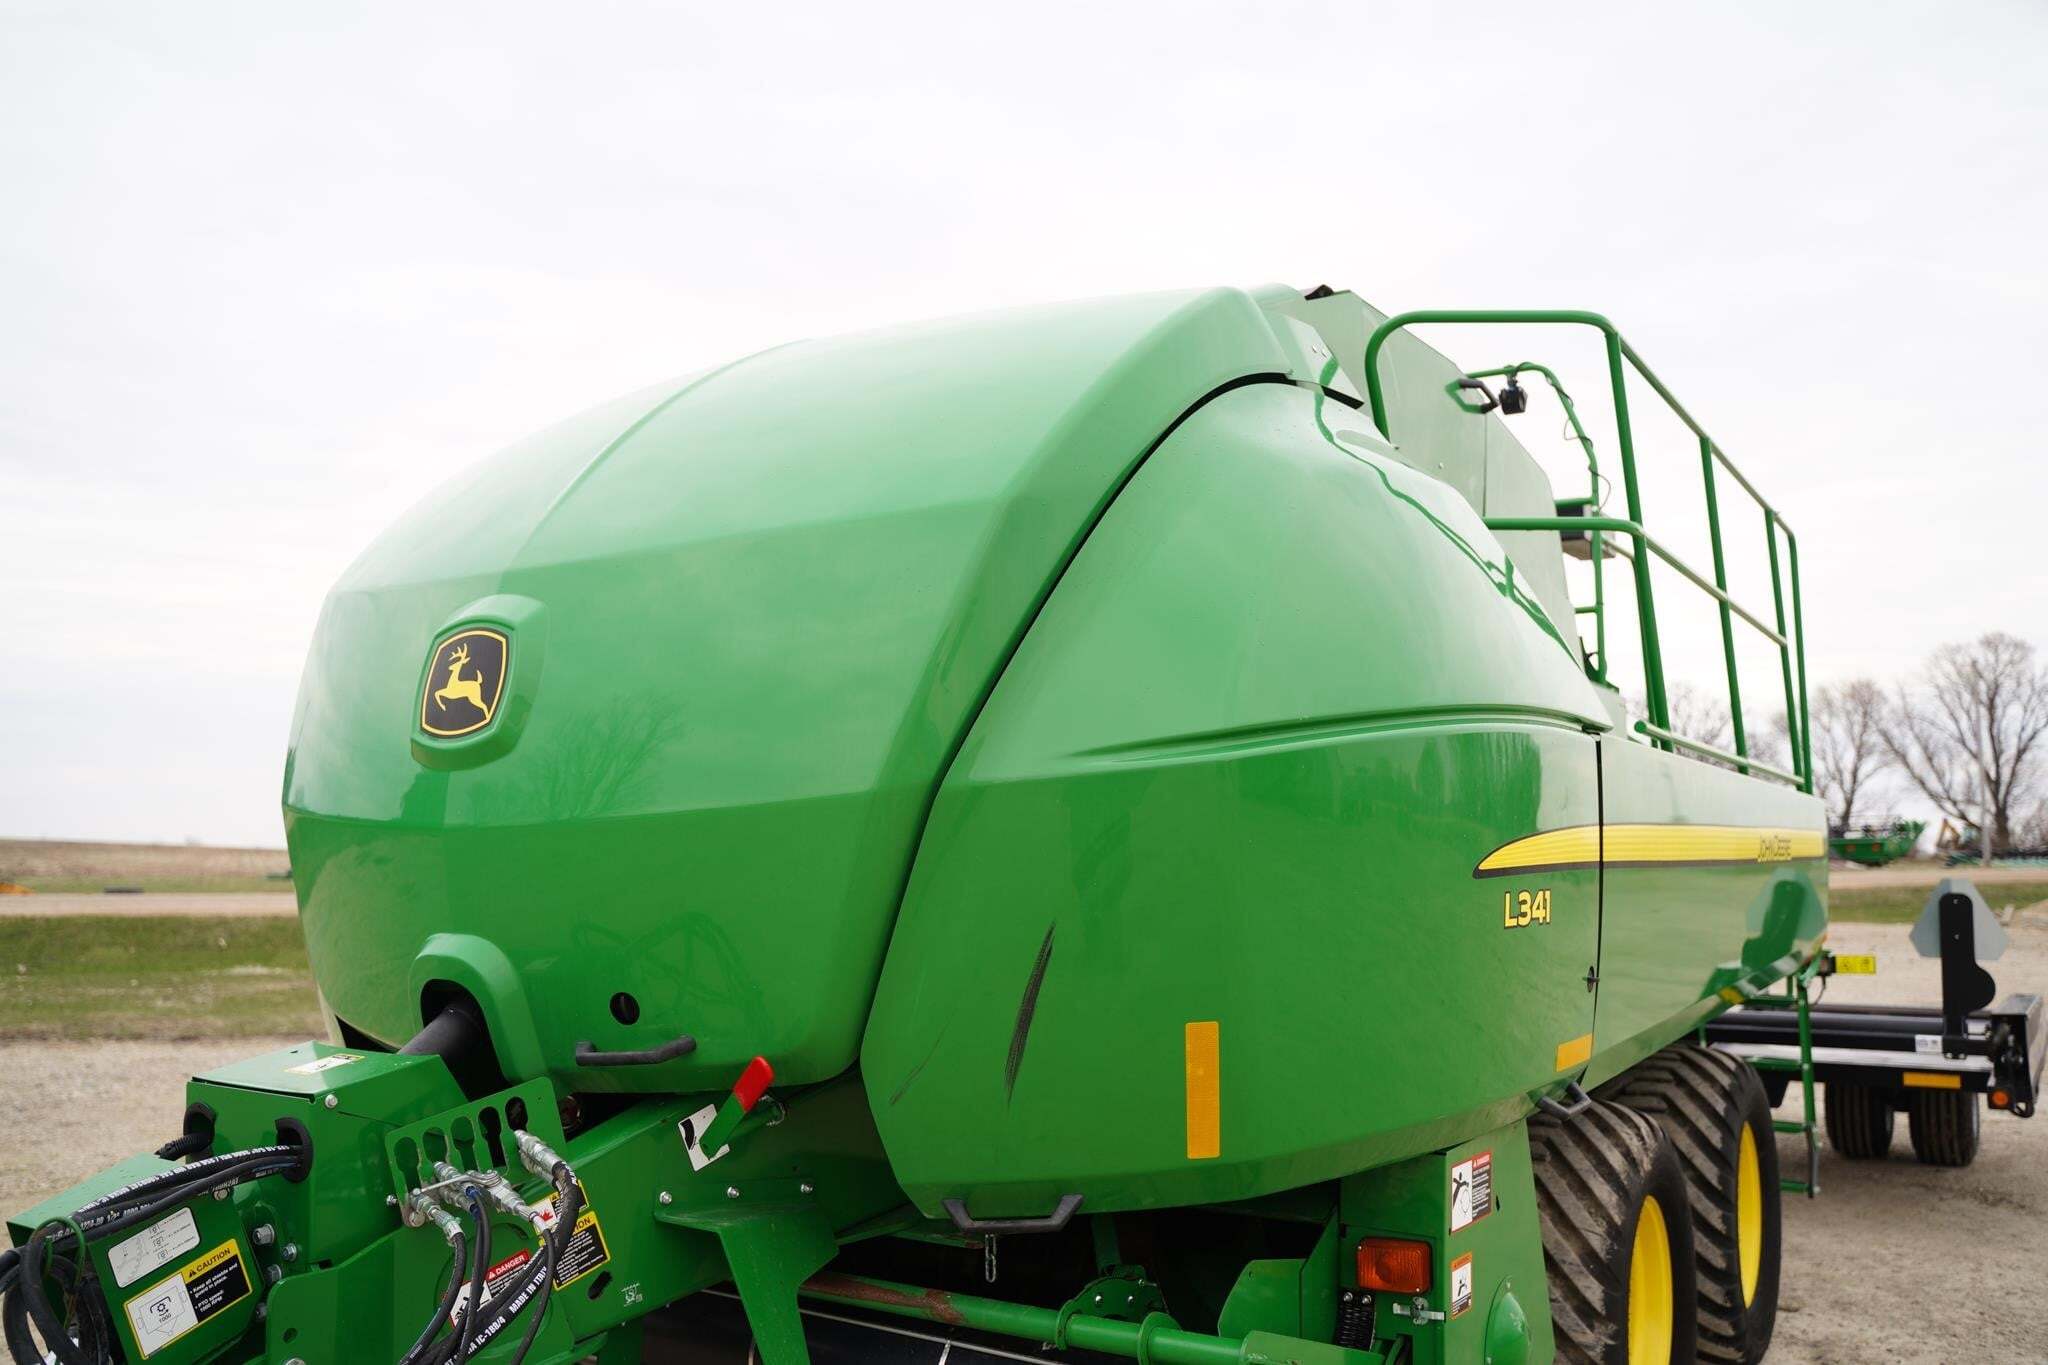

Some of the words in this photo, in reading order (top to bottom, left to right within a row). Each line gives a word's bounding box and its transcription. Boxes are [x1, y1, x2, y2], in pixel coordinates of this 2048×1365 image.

[1504, 889, 1551, 929] L341
[197, 1248, 231, 1271] CAUTION
[496, 1255, 525, 1276] DANGER
[509, 1292, 530, 1313] MADE
[526, 1283, 537, 1295] IN
